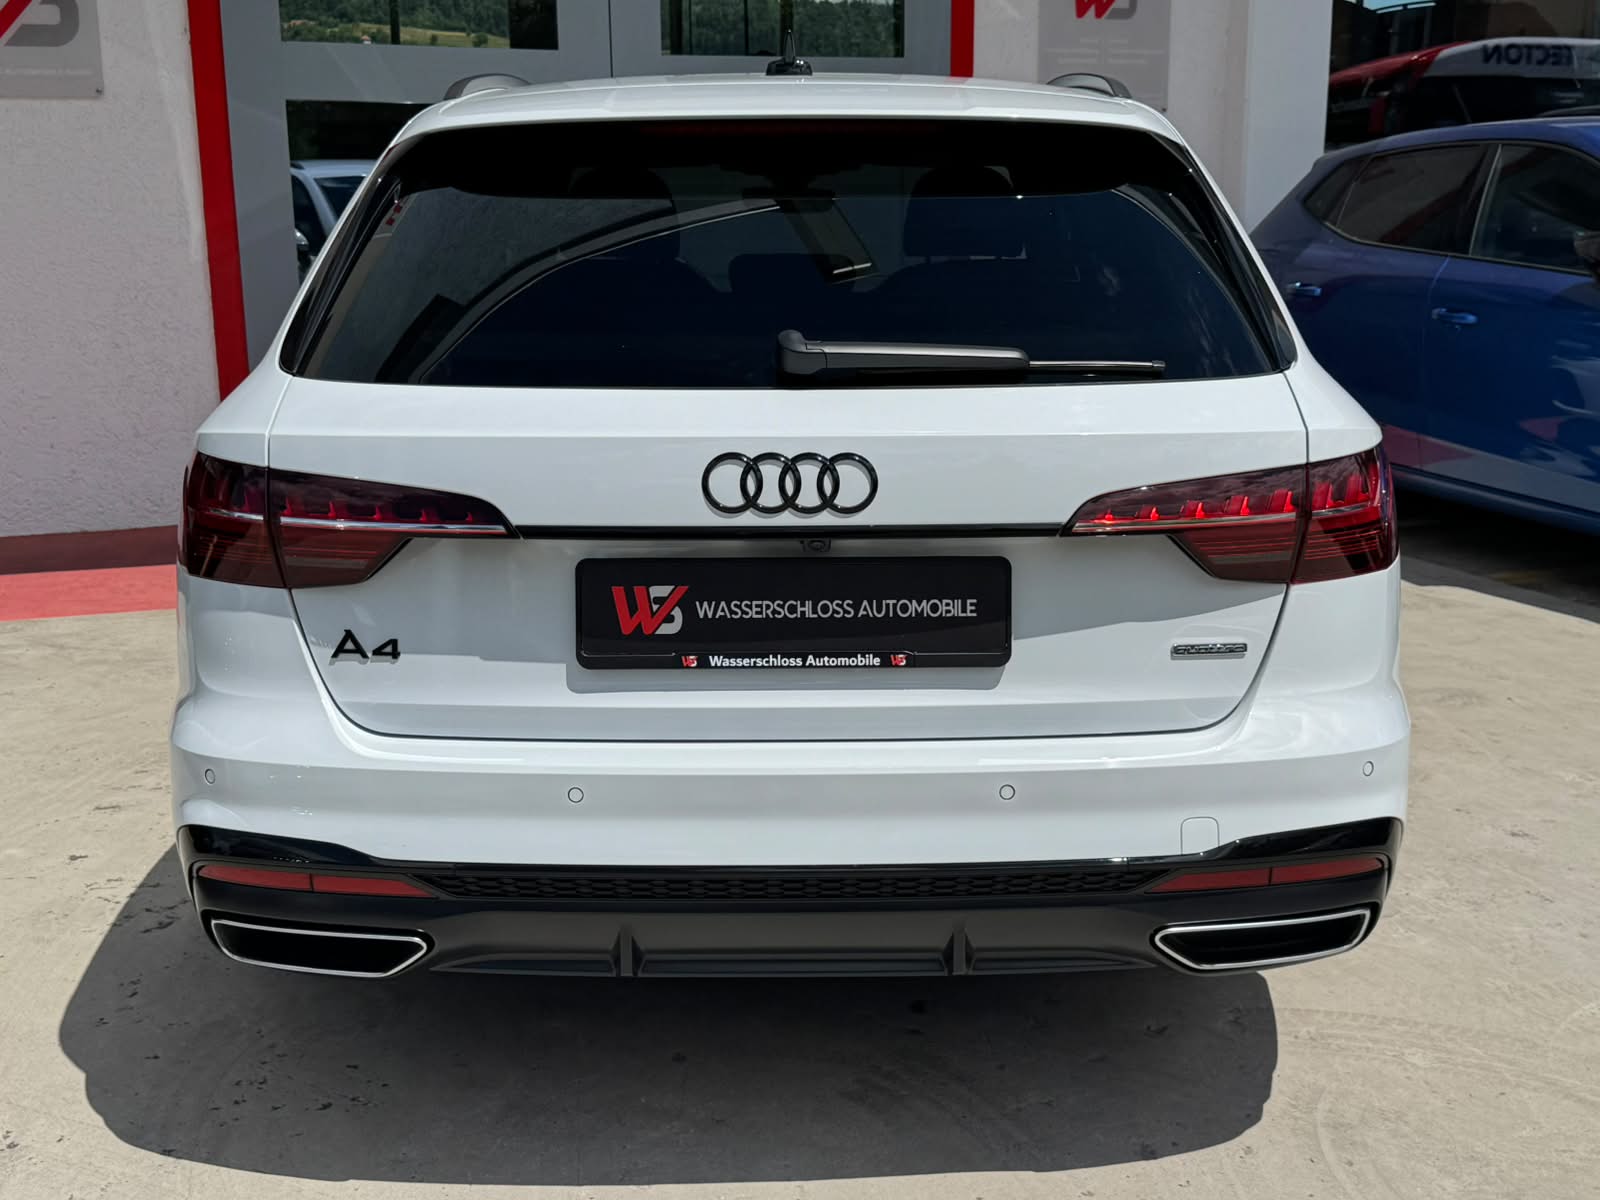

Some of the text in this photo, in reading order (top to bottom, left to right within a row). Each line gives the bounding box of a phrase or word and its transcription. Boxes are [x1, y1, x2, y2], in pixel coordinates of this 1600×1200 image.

[696, 600, 854, 619] WASSERSCHLOSS
[857, 599, 977, 618] AUTOMOBILE
[330, 629, 401, 660] A4
[709, 655, 803, 667] Wasserschloss
[806, 654, 881, 667] Automobile
